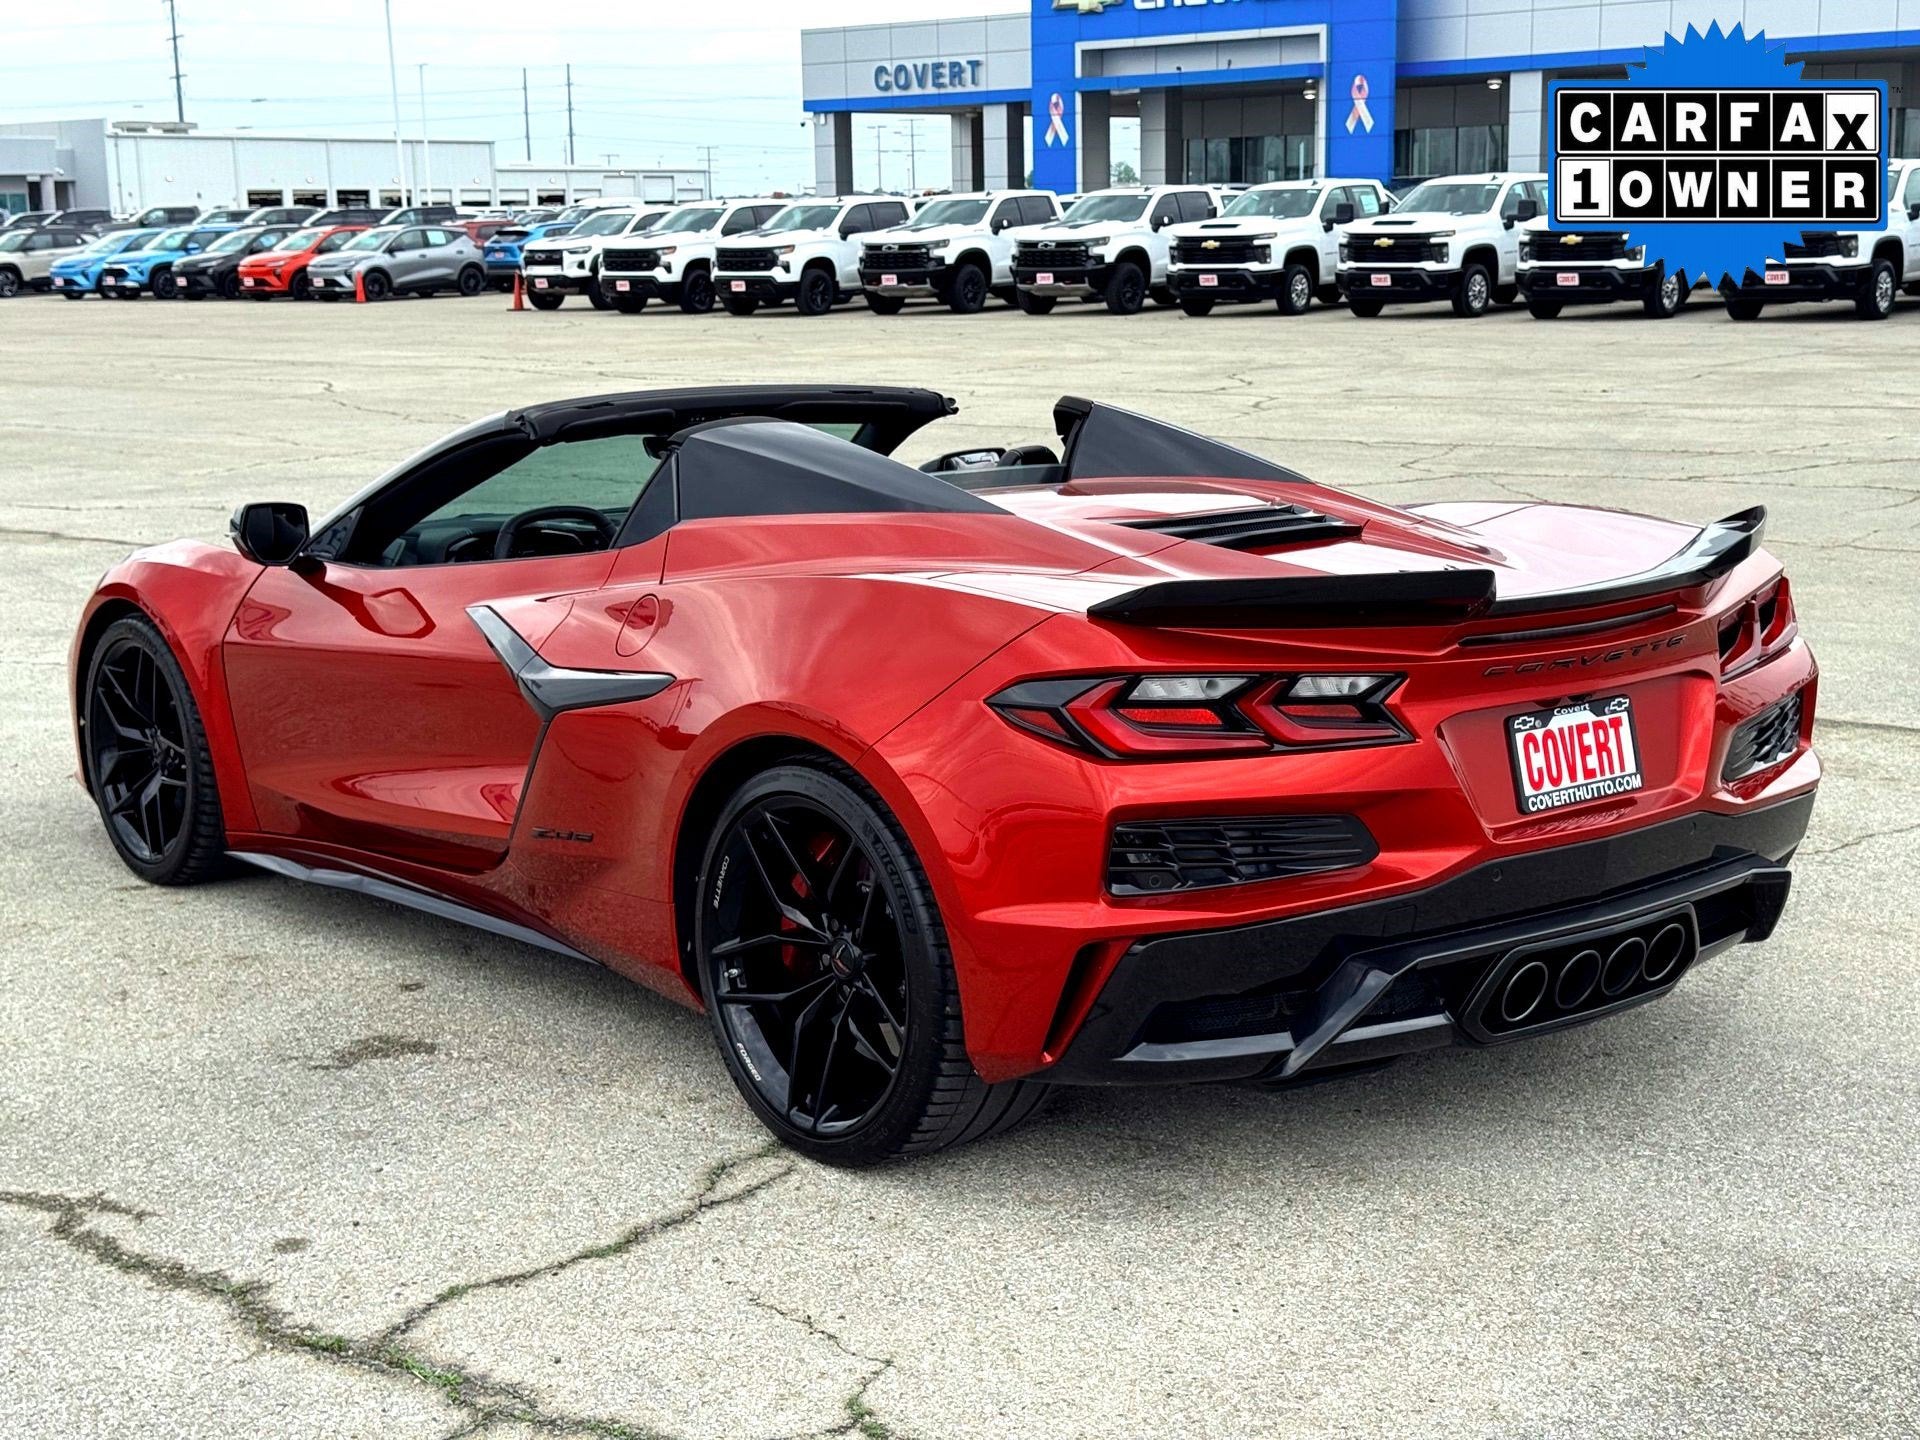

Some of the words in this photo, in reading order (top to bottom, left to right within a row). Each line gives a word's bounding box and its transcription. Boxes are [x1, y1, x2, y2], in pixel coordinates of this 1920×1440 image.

[874, 60, 983, 91] COVERT
[1484, 634, 1687, 676] CORVETTE
[1554, 703, 1590, 716] Covert
[1523, 716, 1626, 792] COVERT
[1528, 774, 1642, 812] COVERTHUTTO.COM
[713, 855, 730, 910] CORVETTE
[736, 1042, 762, 1081] FORGED
